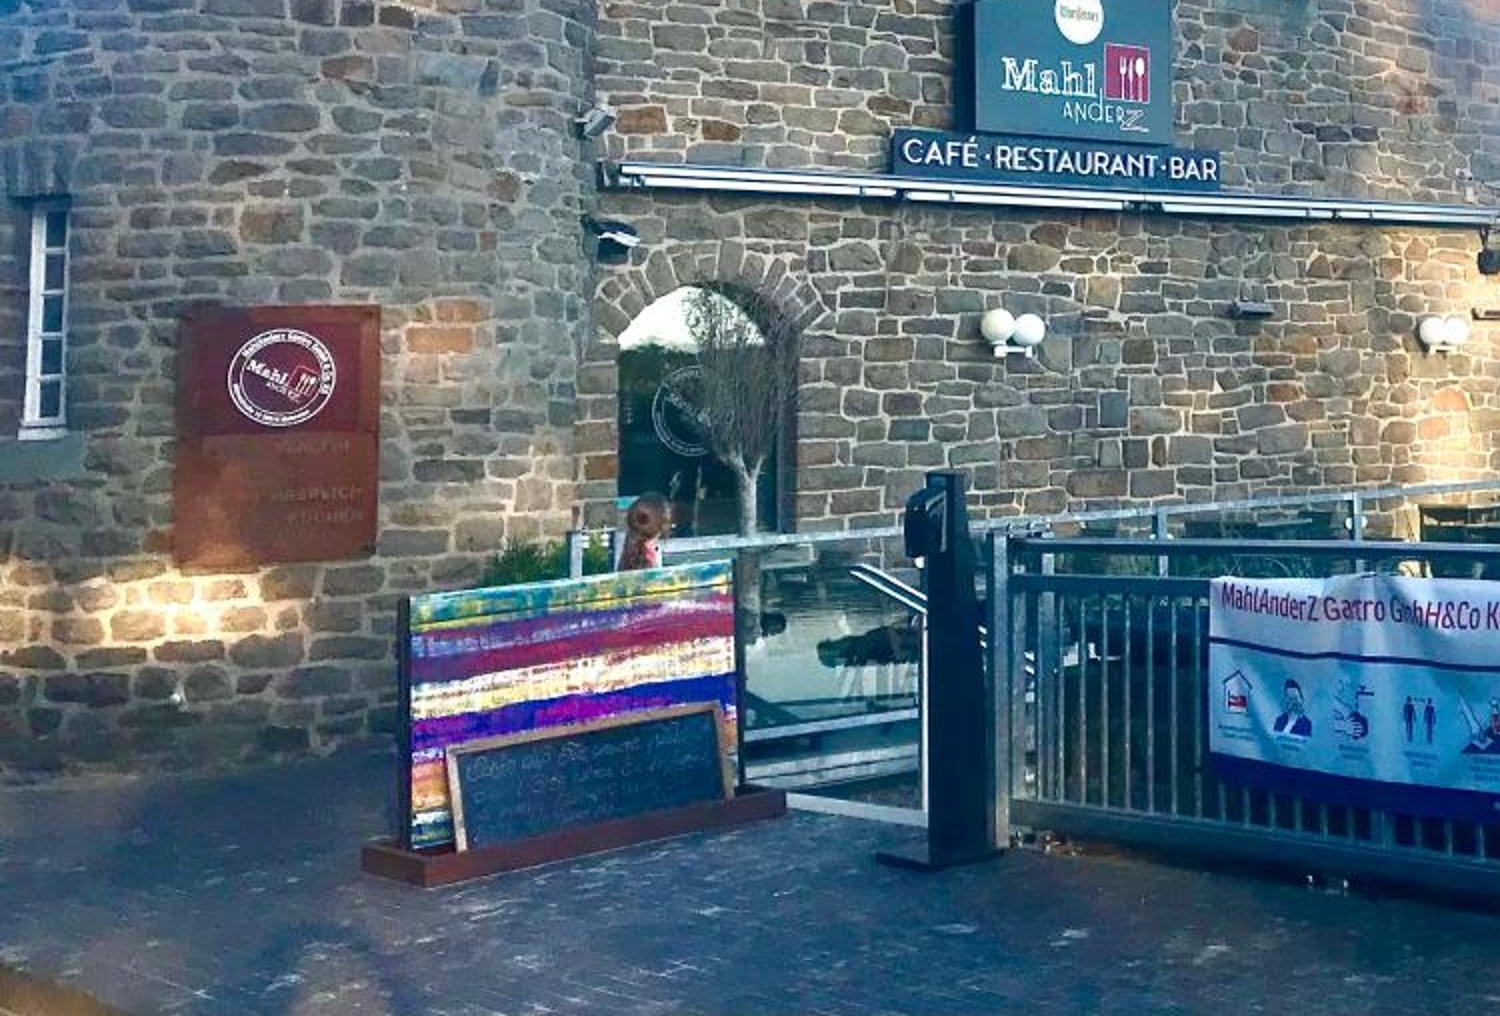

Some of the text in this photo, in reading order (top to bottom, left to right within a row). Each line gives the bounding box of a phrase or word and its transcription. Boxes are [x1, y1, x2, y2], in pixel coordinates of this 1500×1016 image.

[1001, 56, 1097, 98] Mahl
[902, 135, 1217, 182] CAFÉ RESTAURANT BAR
